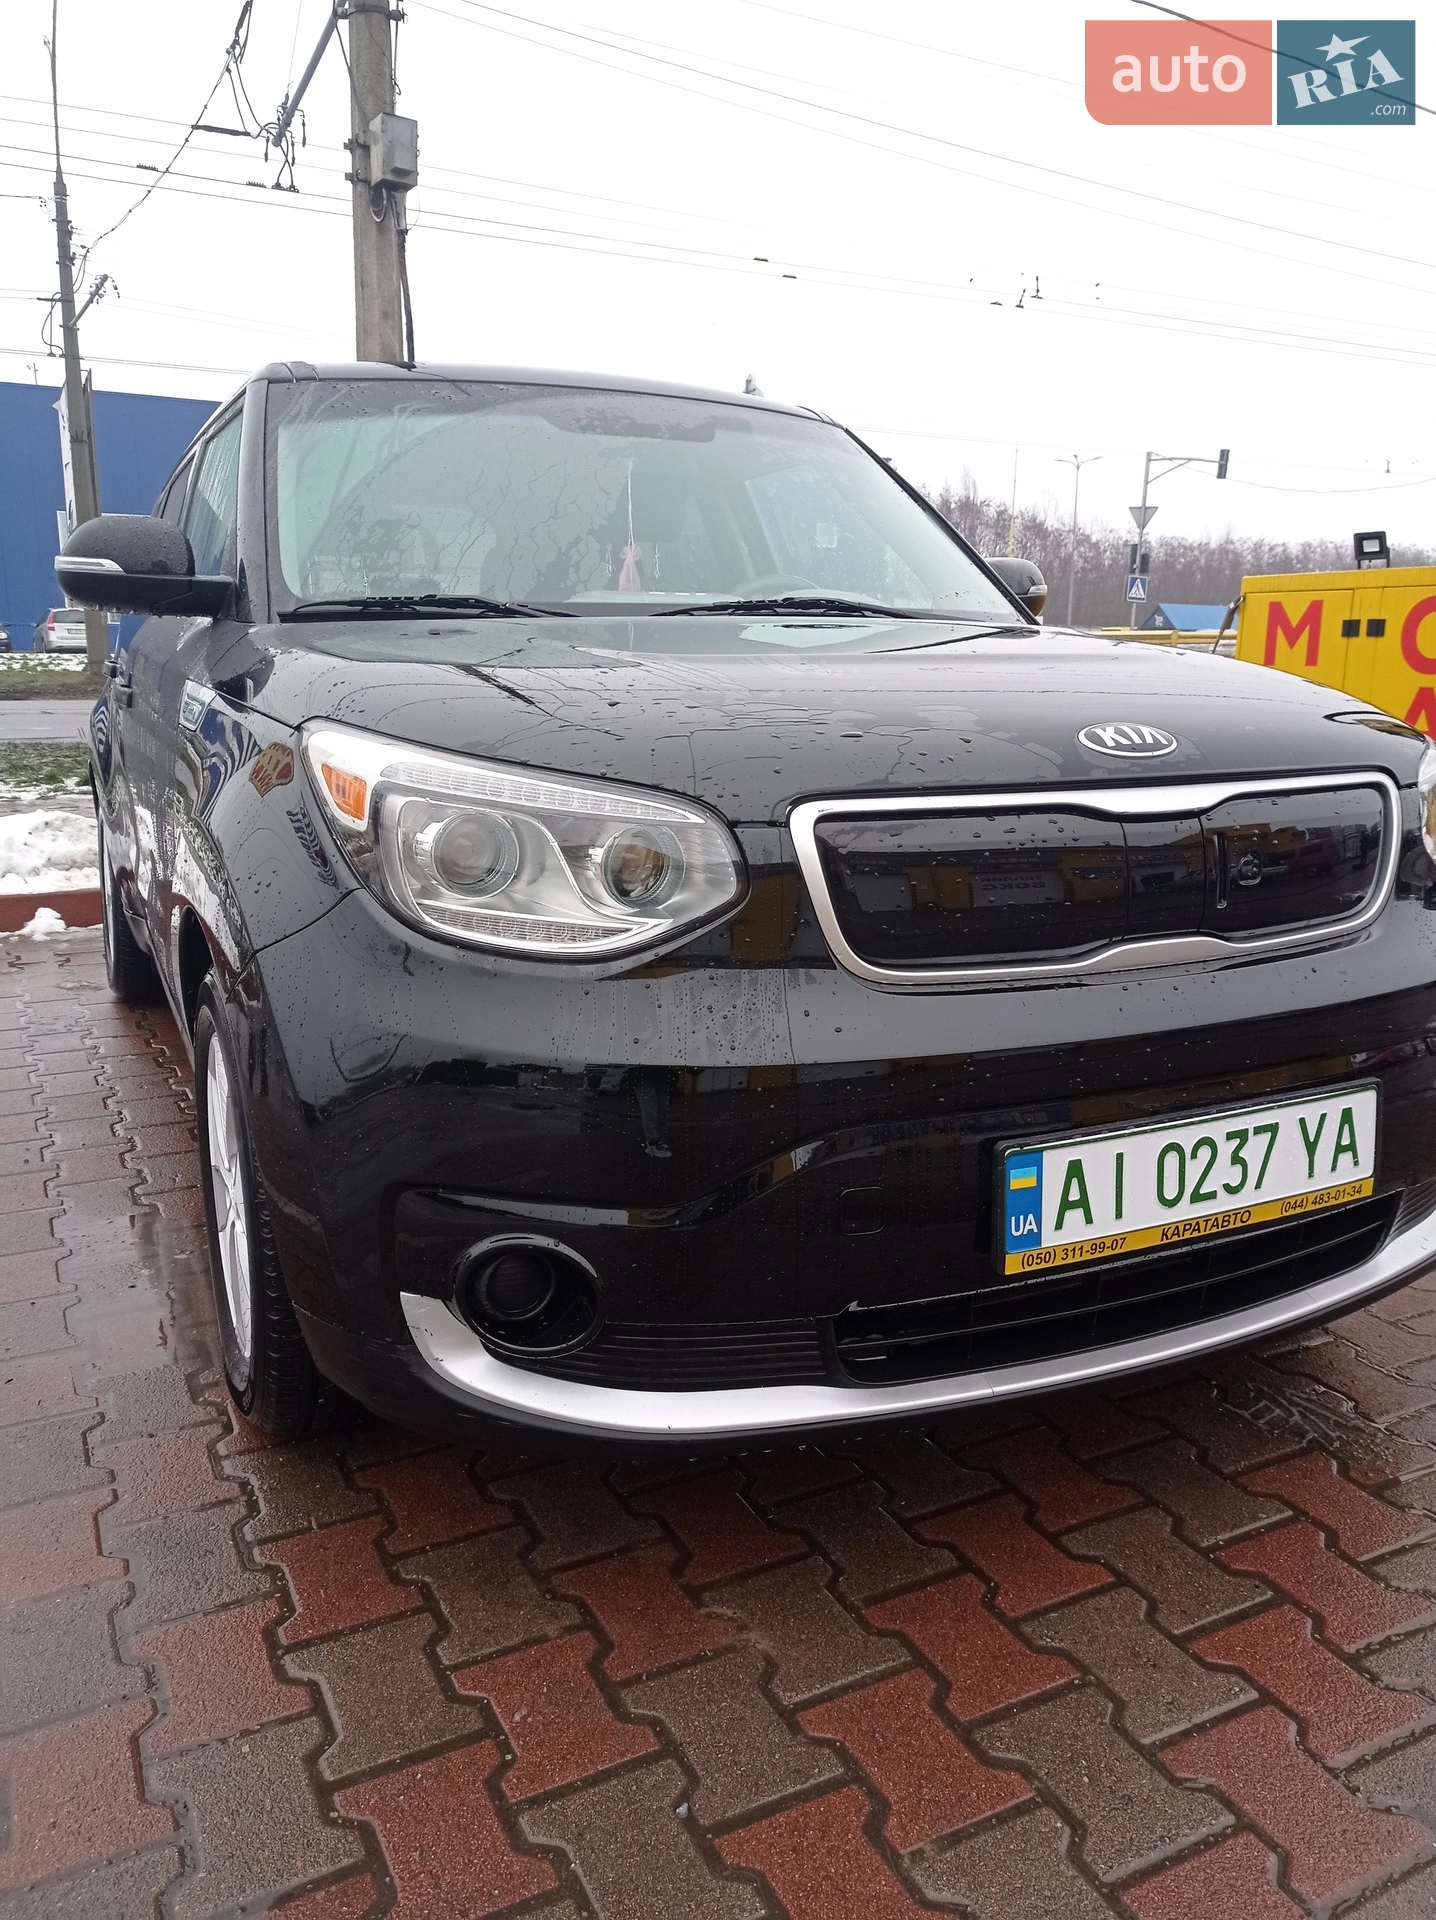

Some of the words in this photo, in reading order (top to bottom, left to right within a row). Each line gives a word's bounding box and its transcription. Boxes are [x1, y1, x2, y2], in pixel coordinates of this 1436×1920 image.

[1090, 725, 1169, 747] KIA
[1053, 1151, 1125, 1231] AI
[1156, 1121, 1280, 1209] 0237
[1298, 1106, 1360, 1178] YA
[1010, 1212, 1038, 1237] UA
[1020, 1249, 1057, 1270] (050)
[1060, 1236, 1127, 1261] 311-99-07
[1160, 1209, 1252, 1242] КАРАТАВТО
[1279, 1196, 1309, 1216] (044)
[1310, 1183, 1364, 1207] 483-01-34
